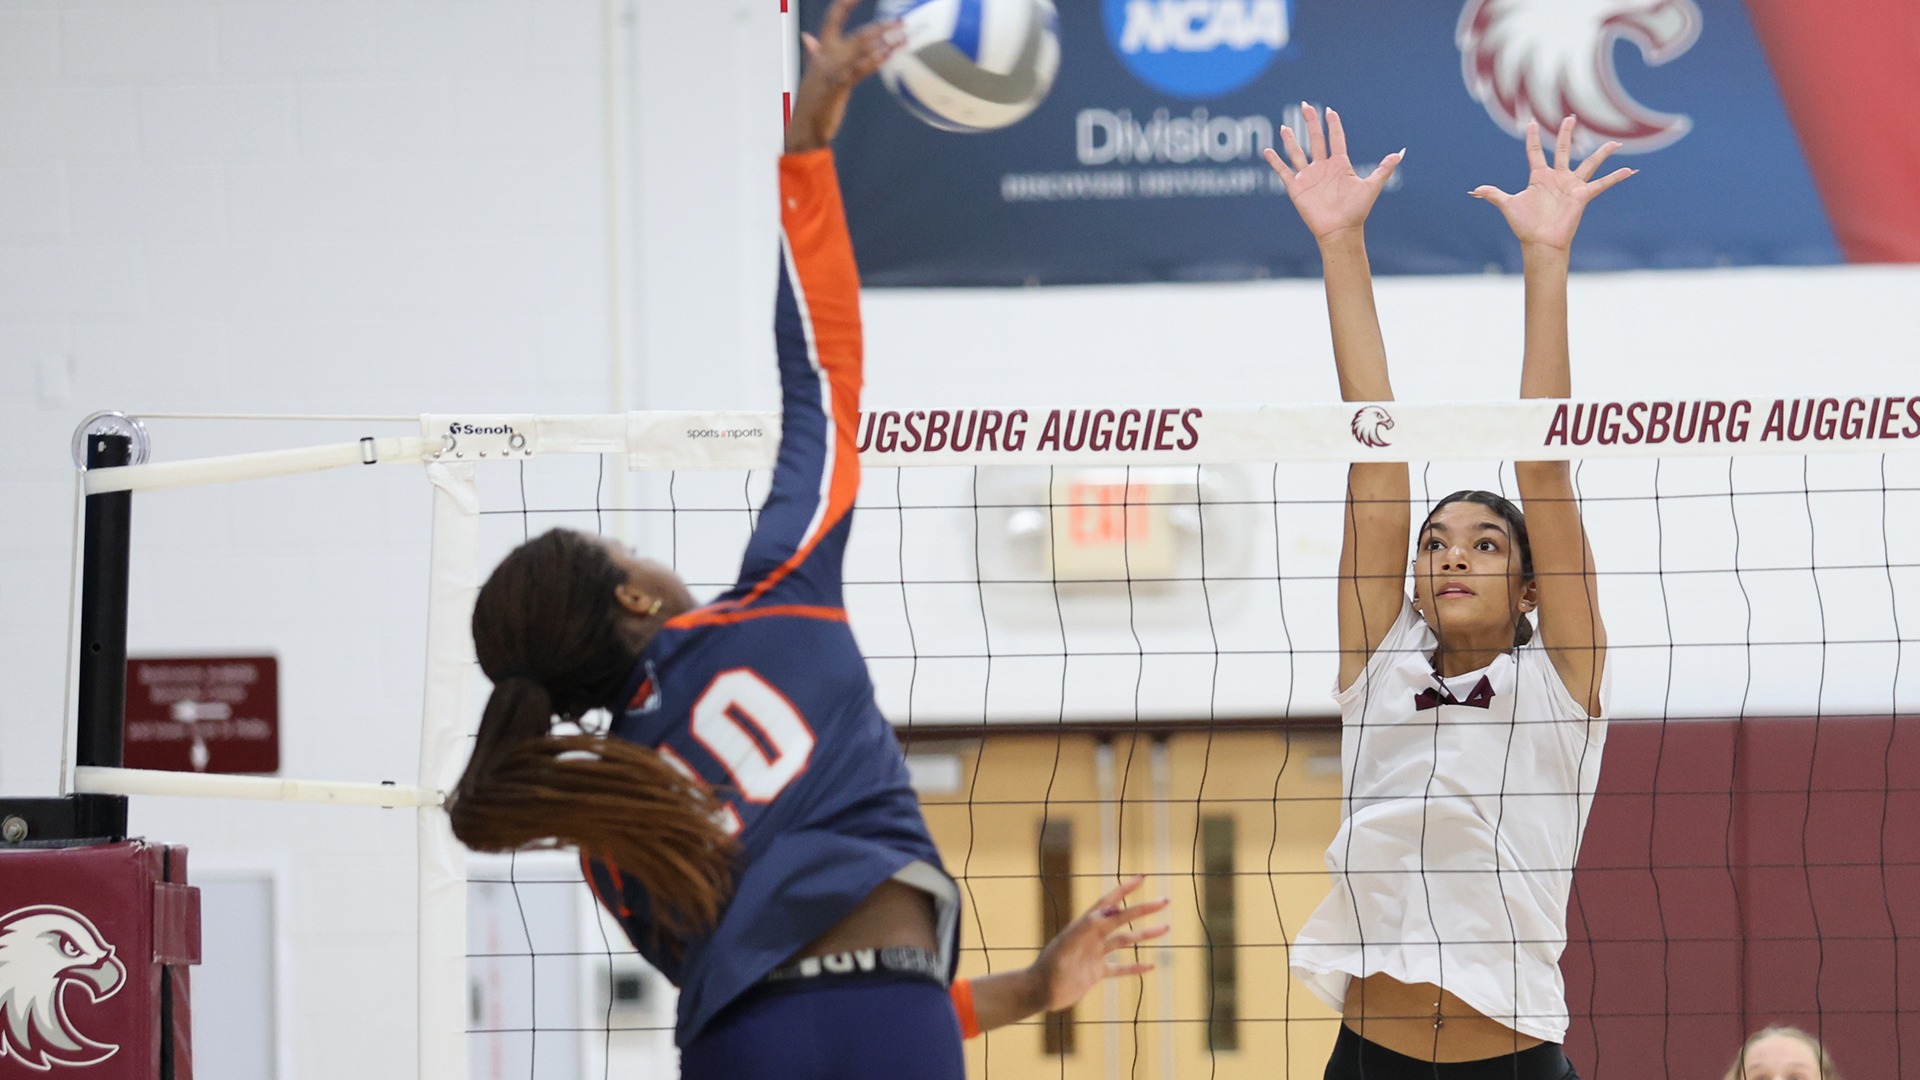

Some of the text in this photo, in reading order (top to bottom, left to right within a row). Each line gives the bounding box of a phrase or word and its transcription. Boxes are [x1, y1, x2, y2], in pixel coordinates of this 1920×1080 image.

[1121, 0, 1290, 53] NCAA
[1076, 107, 1273, 164] Division
[464, 424, 513, 435] Senoh
[687, 429, 720, 439] sports
[856, 408, 1203, 452] UGSBURG AUGGIES
[1544, 396, 1920, 446] AUGSBURG AUGGIES
